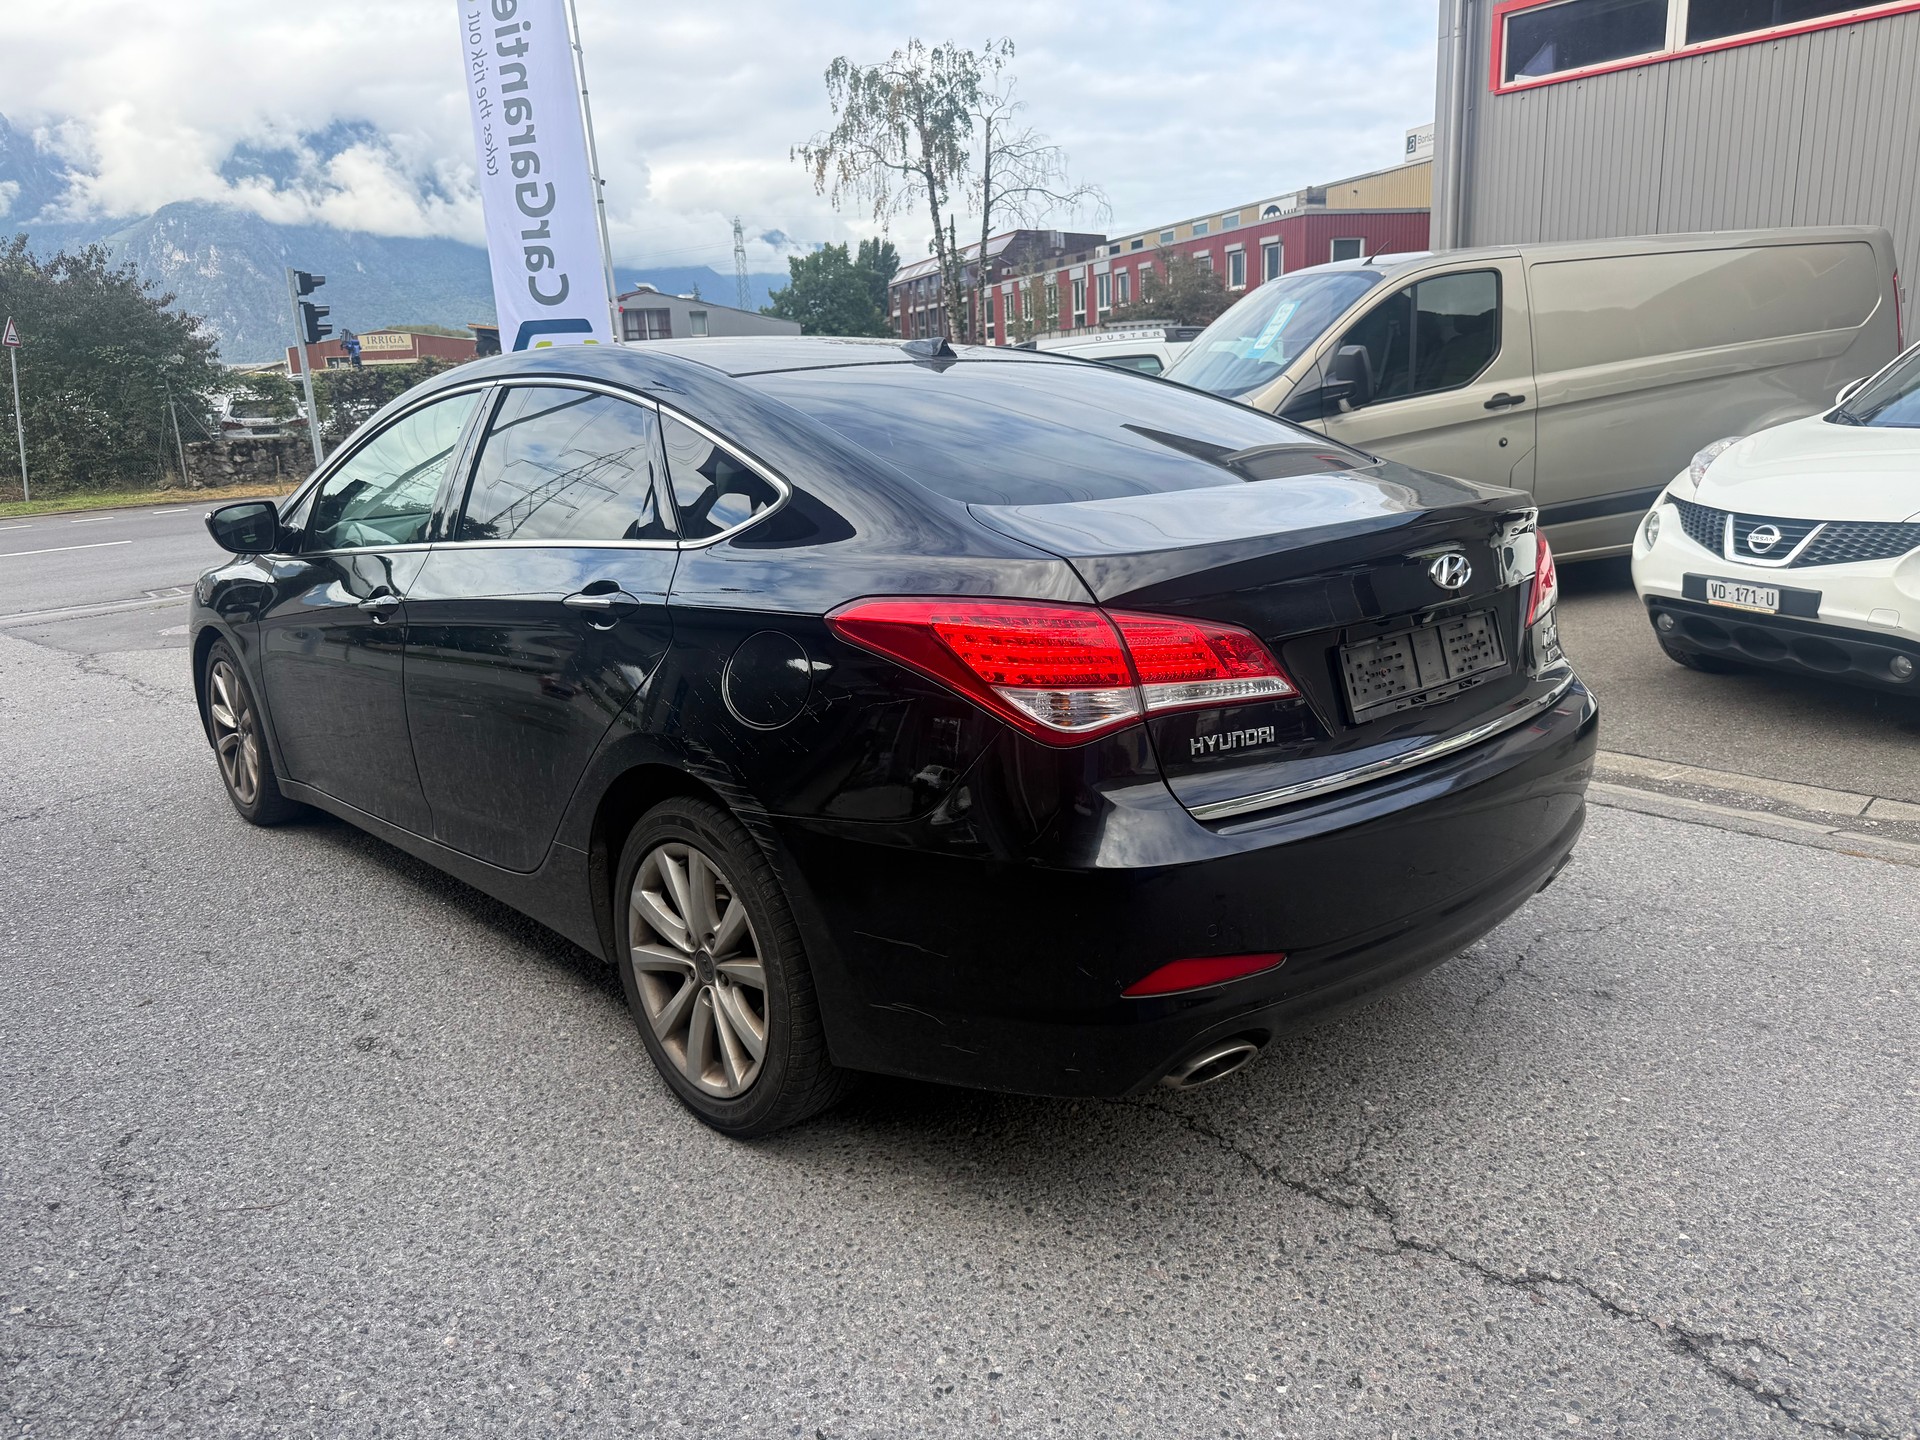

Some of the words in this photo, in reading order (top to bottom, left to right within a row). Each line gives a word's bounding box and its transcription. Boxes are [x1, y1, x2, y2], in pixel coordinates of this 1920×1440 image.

[366, 335, 405, 345] IRRIGA
[1095, 330, 1161, 342] DUSTER
[1189, 725, 1275, 756] HYUNDAI
